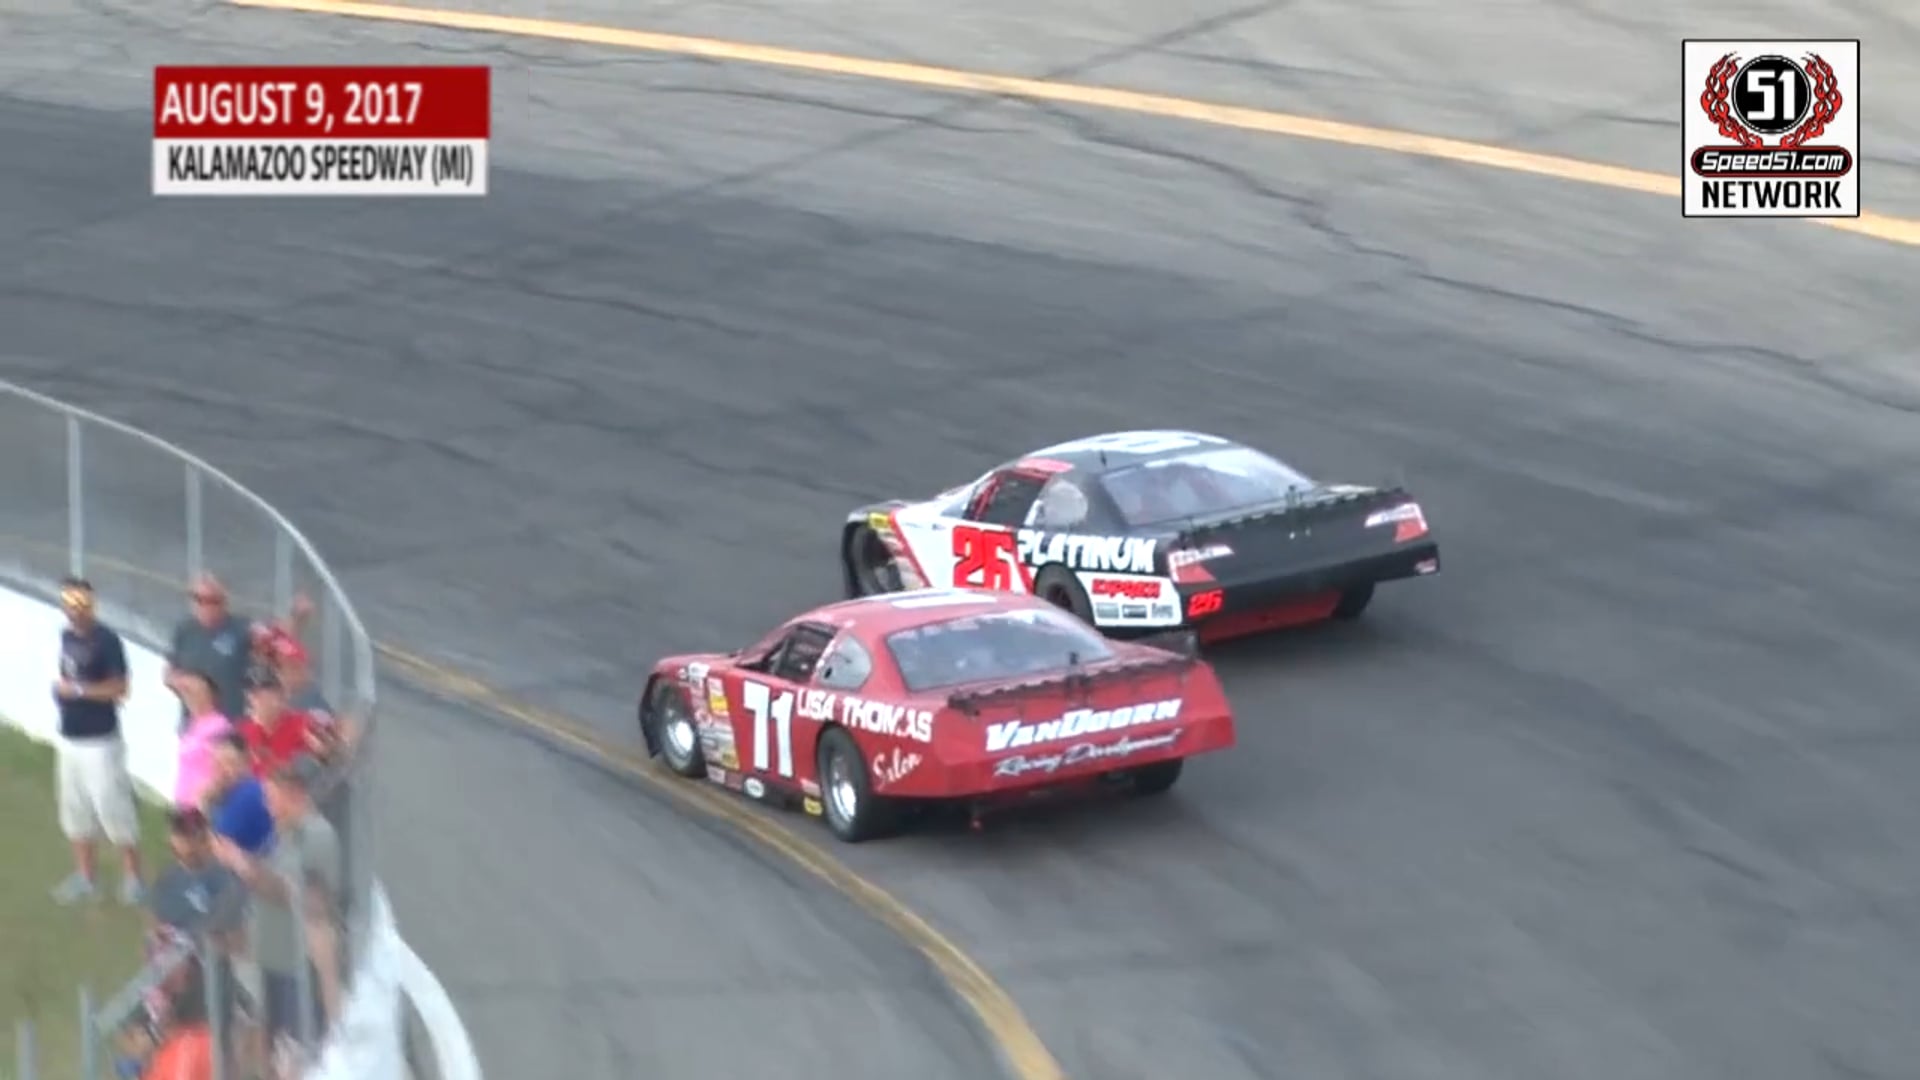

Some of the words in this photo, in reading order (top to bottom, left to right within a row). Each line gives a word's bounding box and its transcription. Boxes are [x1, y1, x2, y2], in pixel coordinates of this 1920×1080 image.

[952, 525, 1014, 592] 26
[1017, 528, 1157, 572] PLATINUM
[1187, 588, 1224, 618] 26
[743, 679, 794, 778] 71
[796, 687, 833, 720] LISA
[841, 696, 933, 743] THOMAS
